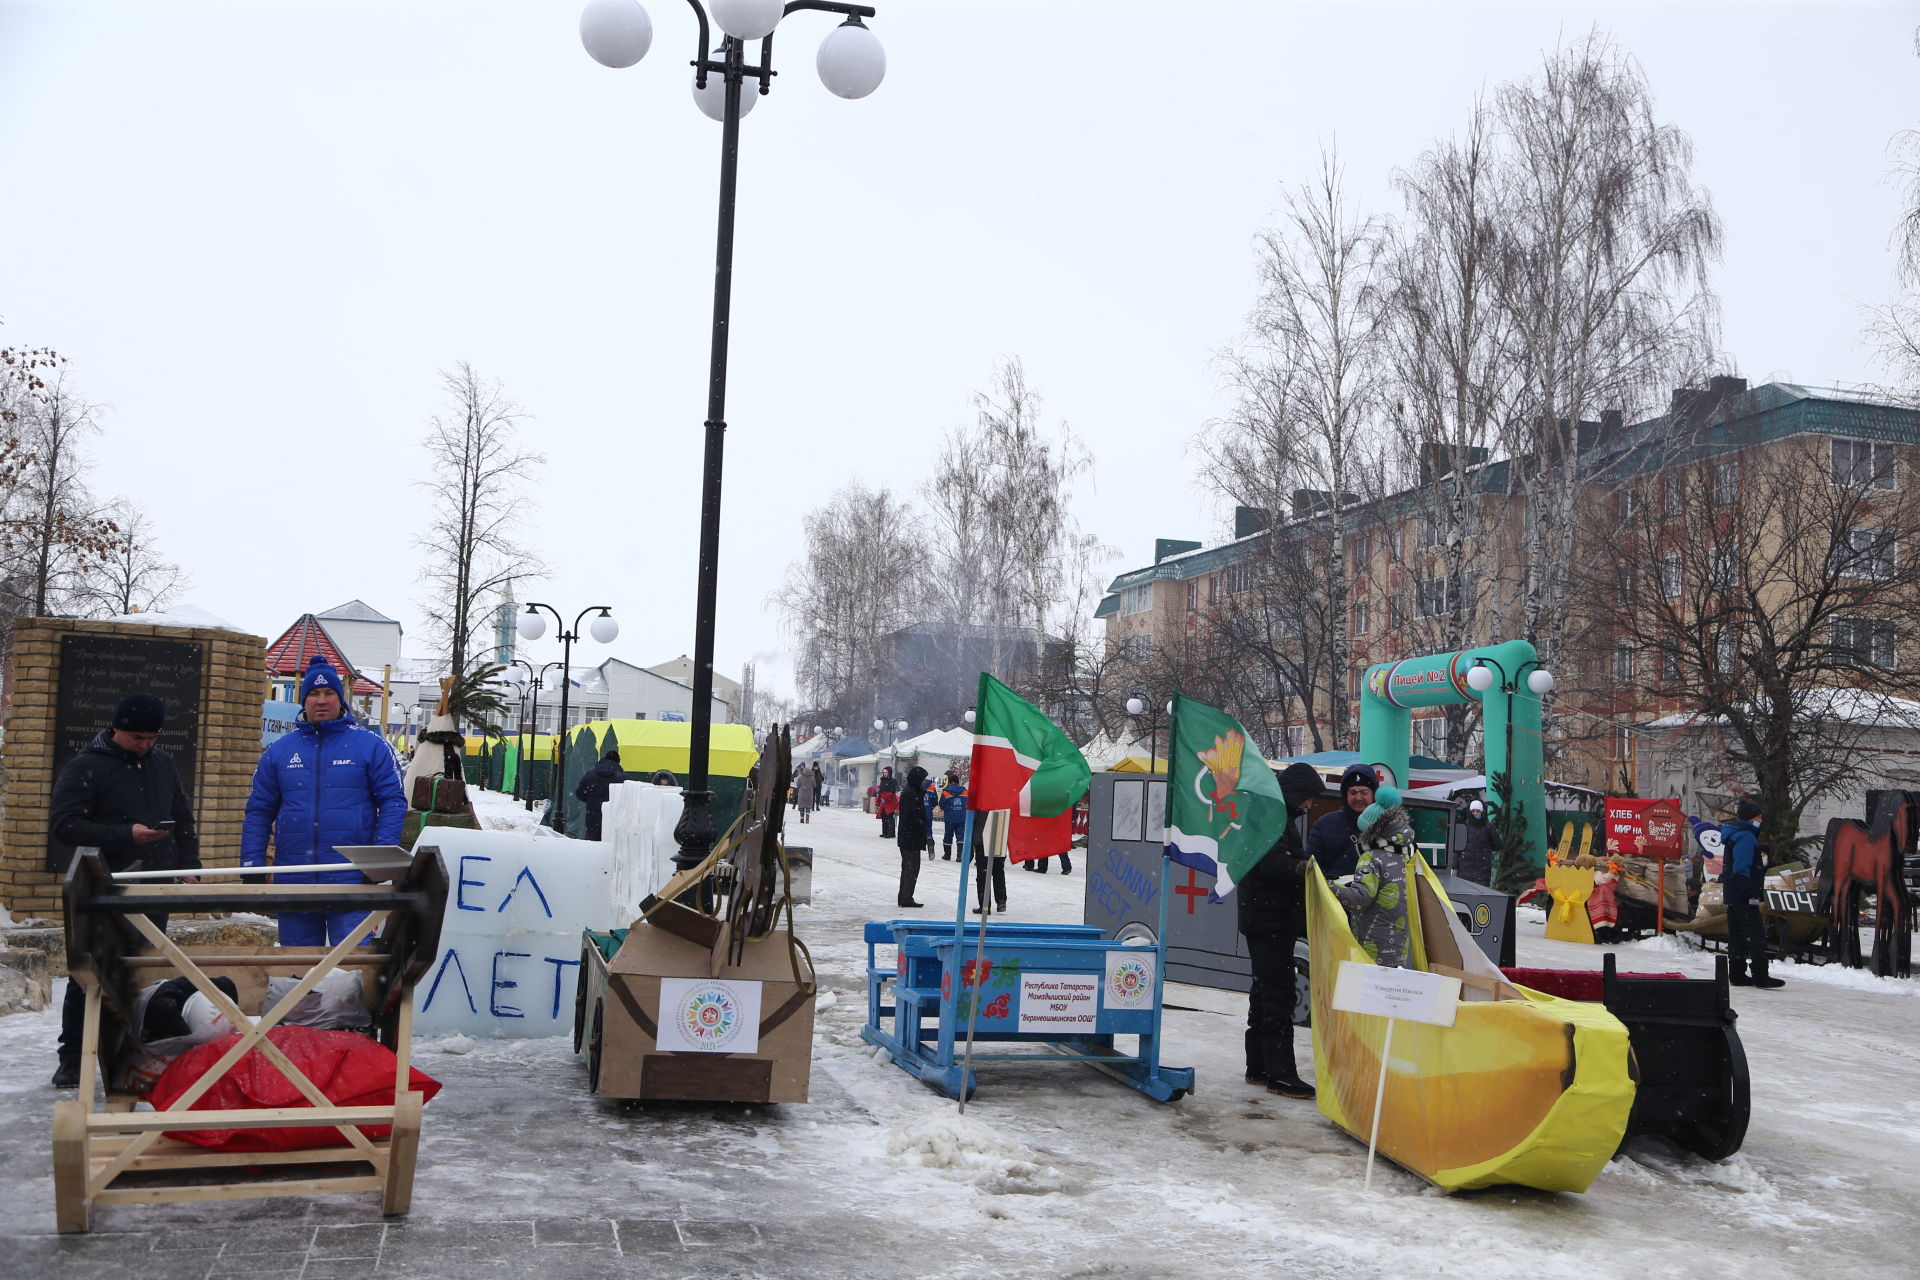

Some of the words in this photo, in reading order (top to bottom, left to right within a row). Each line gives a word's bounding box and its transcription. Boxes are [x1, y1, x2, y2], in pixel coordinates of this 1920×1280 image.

[1393, 671, 1424, 687] Лицей
[1427, 669, 1446, 682] №2
[1609, 809, 1633, 819] ХЛЕБ
[1614, 824, 1632, 834] МИР
[1105, 849, 1159, 906] SUNNY
[1090, 872, 1132, 922] ФЕСТ
[1766, 890, 1818, 912] ПОЧ
[1024, 982, 1059, 991] Республика
[1060, 982, 1095, 992] Татарстан
[1028, 992, 1071, 1001] Мамадышский
[1072, 993, 1091, 1003] район
[1050, 1003, 1068, 1012] МБОУ
[699, 1041, 716, 1050] 2021
